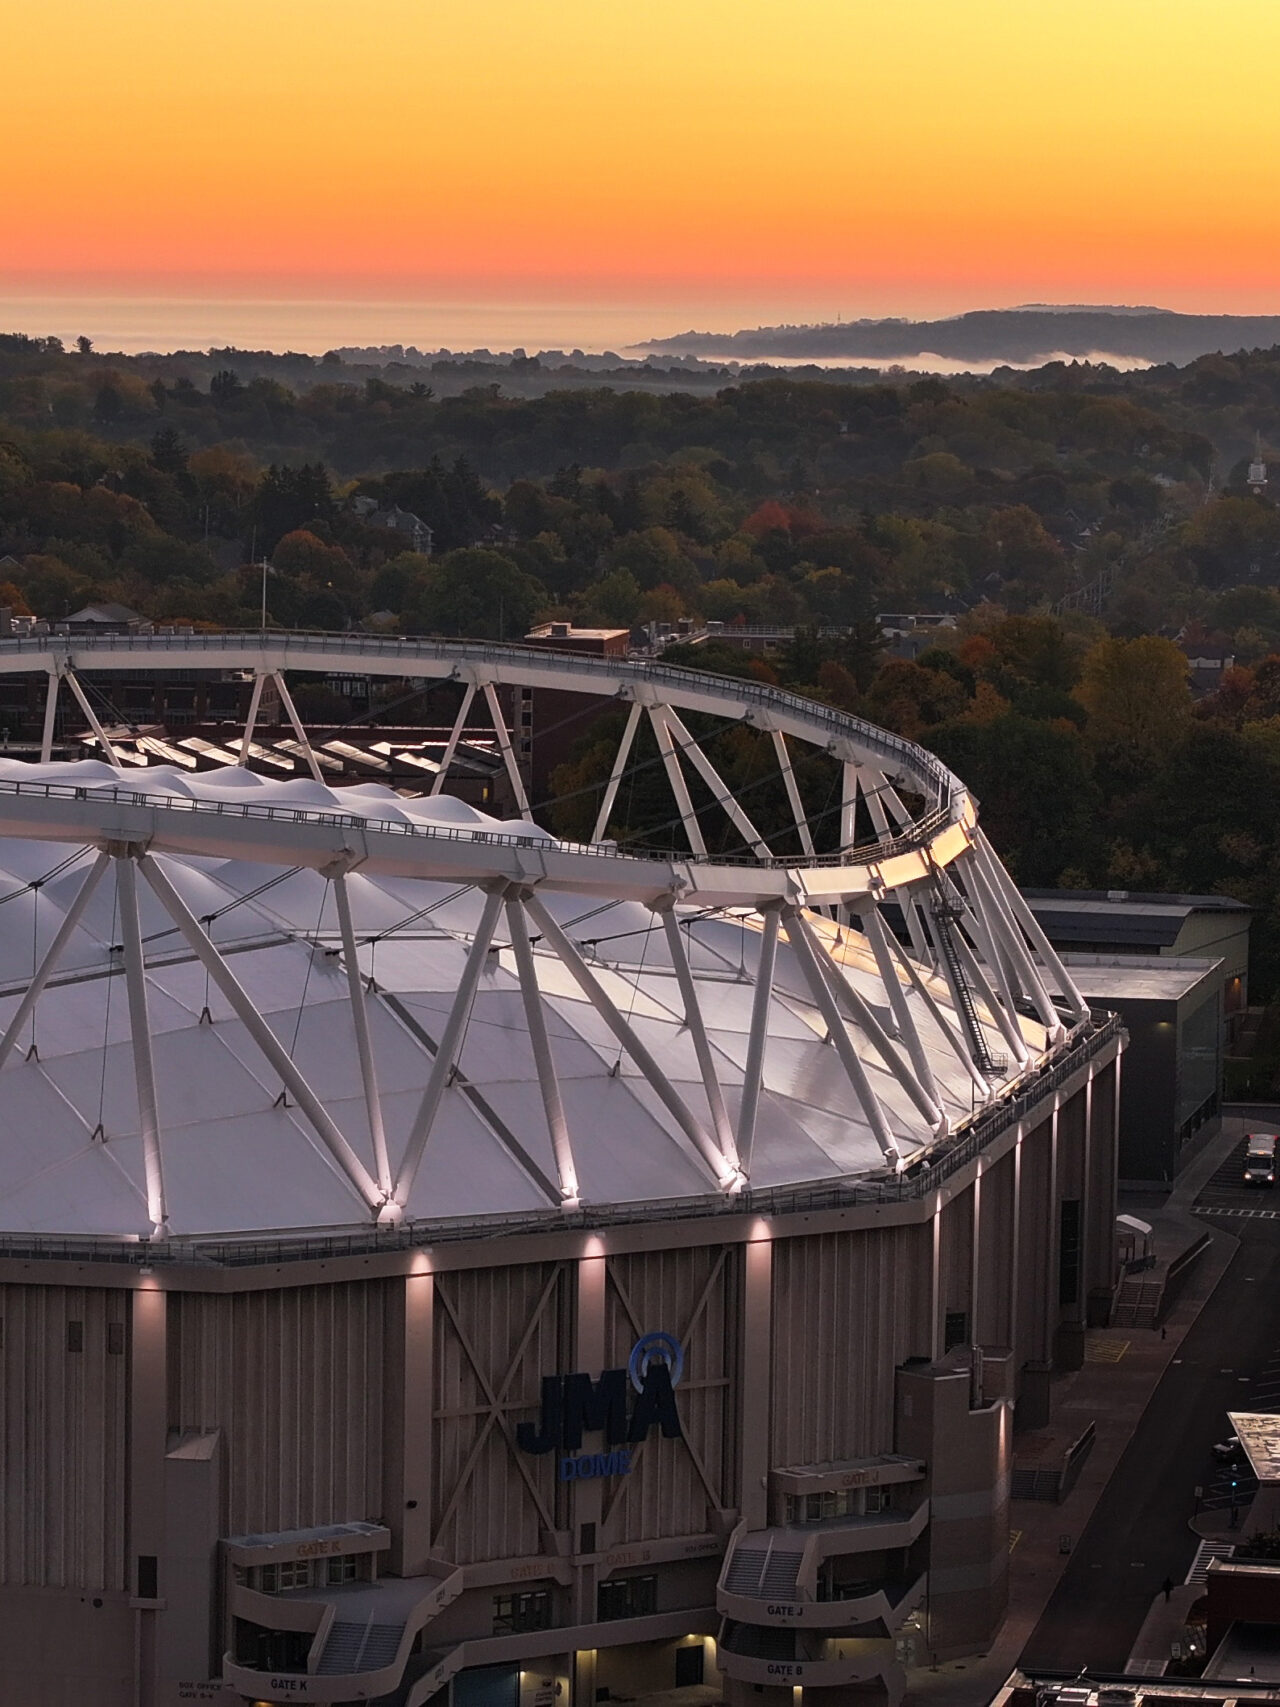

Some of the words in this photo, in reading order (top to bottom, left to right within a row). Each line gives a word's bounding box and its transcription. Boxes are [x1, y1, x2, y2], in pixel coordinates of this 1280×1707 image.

[516, 1362, 684, 1455] JMA
[560, 1450, 633, 1481] DOME
[842, 1471, 870, 1487] GATE
[297, 1541, 328, 1556] GATE
[767, 1605, 793, 1616] GATE
[797, 1606, 803, 1616] J
[767, 1664, 793, 1675] GATE
[796, 1665, 803, 1675] B
[270, 1678, 297, 1690] GATE
[300, 1680, 307, 1691] K
